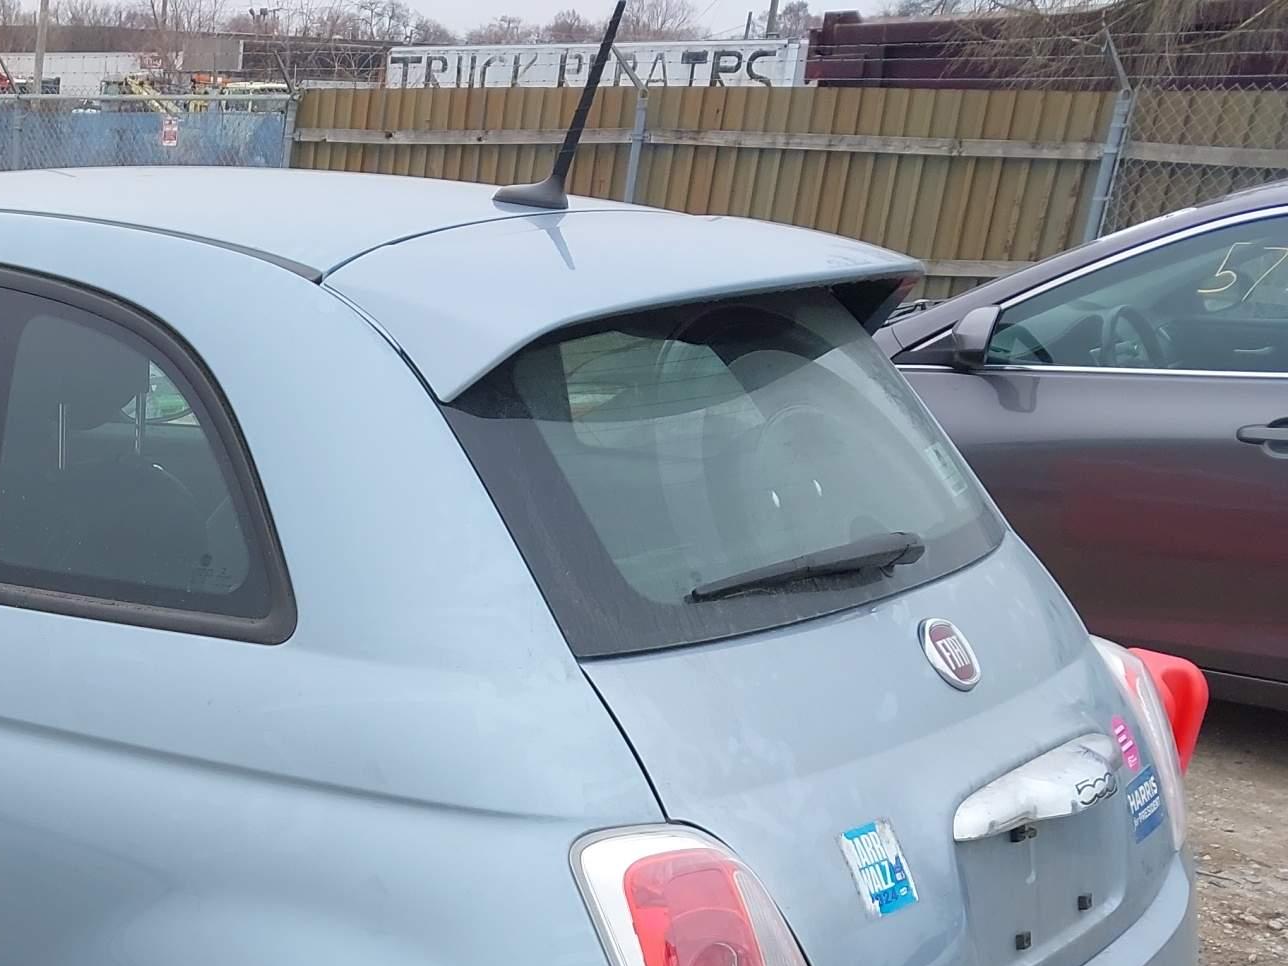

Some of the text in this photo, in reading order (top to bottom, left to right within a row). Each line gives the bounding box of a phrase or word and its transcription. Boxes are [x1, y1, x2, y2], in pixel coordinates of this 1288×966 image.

[390, 52, 538, 88] TRUCK
[935, 635, 972, 671] FIAT
[1075, 772, 1119, 806] 500
[1127, 775, 1158, 815] HARRIS
